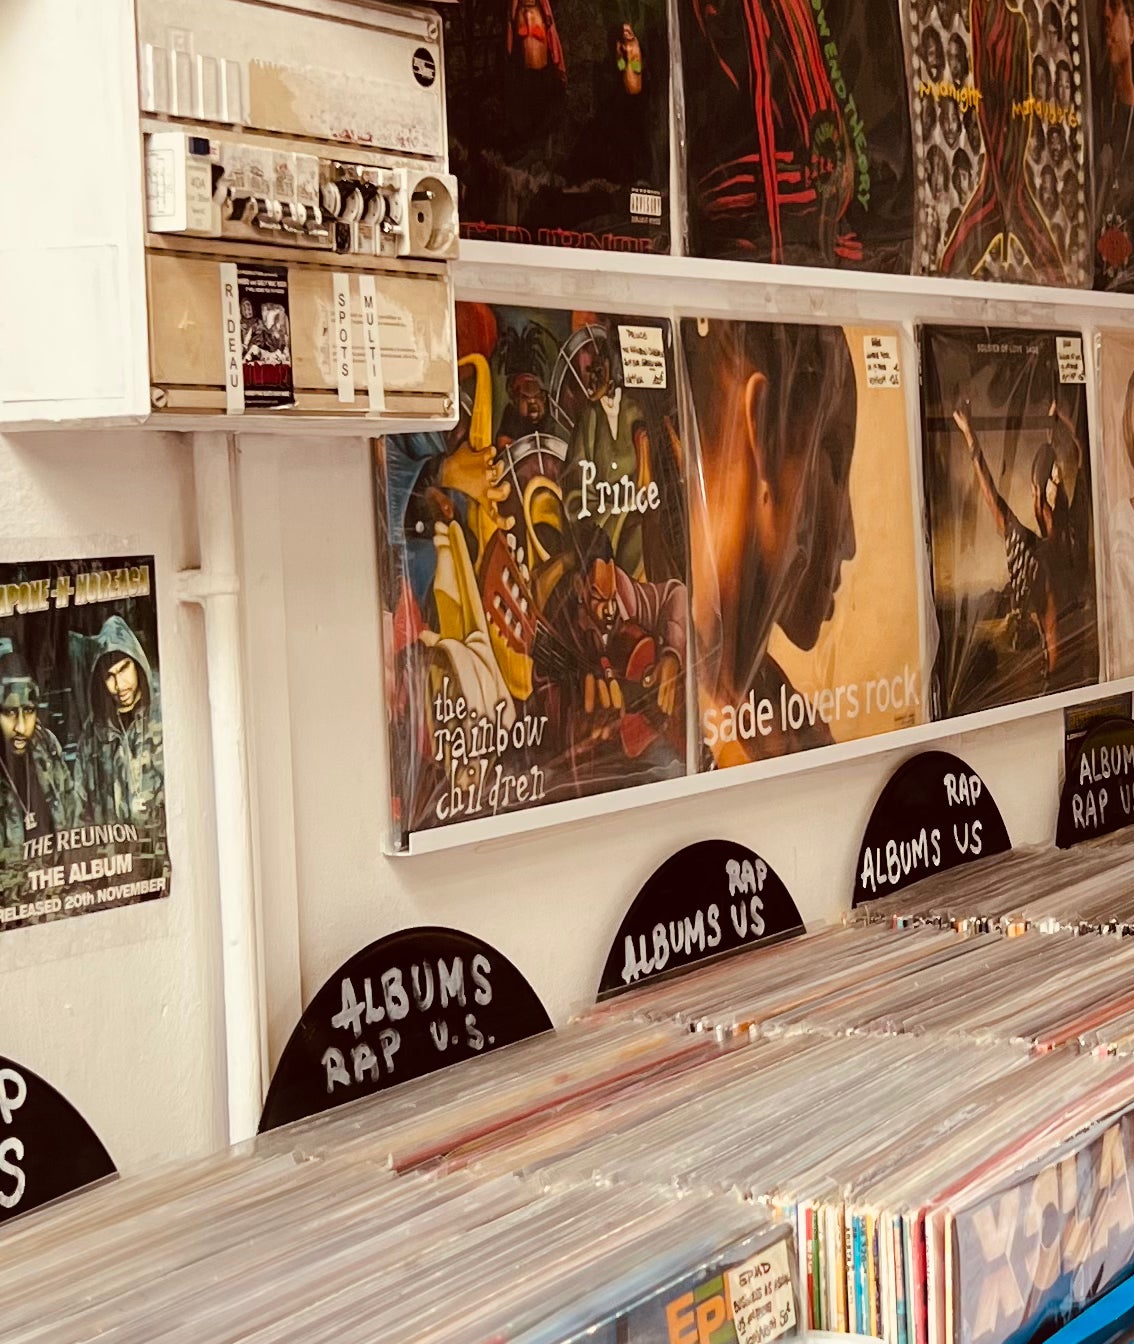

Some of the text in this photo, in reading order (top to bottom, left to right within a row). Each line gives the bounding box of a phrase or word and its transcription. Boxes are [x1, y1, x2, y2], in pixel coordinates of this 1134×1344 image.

[225, 283, 239, 388] RIDEAU
[338, 293, 349, 376] SPOTS
[364, 295, 377, 377] MULTI
[578, 459, 660, 520] Prince
[434, 676, 466, 724] the
[703, 663, 921, 748] sade lovers rock
[434, 702, 548, 762] rainbow
[435, 763, 546, 821] children
[943, 772, 982, 807] RAP
[1071, 787, 1109, 829] RAP
[23, 824, 138, 860] THE REUNION
[28, 853, 133, 891] THE ALBUM
[860, 819, 984, 893] ALBUMS US
[65, 892, 94, 909] 20th
[97, 877, 166, 903] NOVEMBER
[725, 858, 768, 896] RAP
[621, 895, 766, 984] ALBUMS US
[331, 953, 493, 1038] ALBUMS
[321, 1013, 496, 1094] RAP U.S.
[739, 1262, 771, 1287] EPMD
